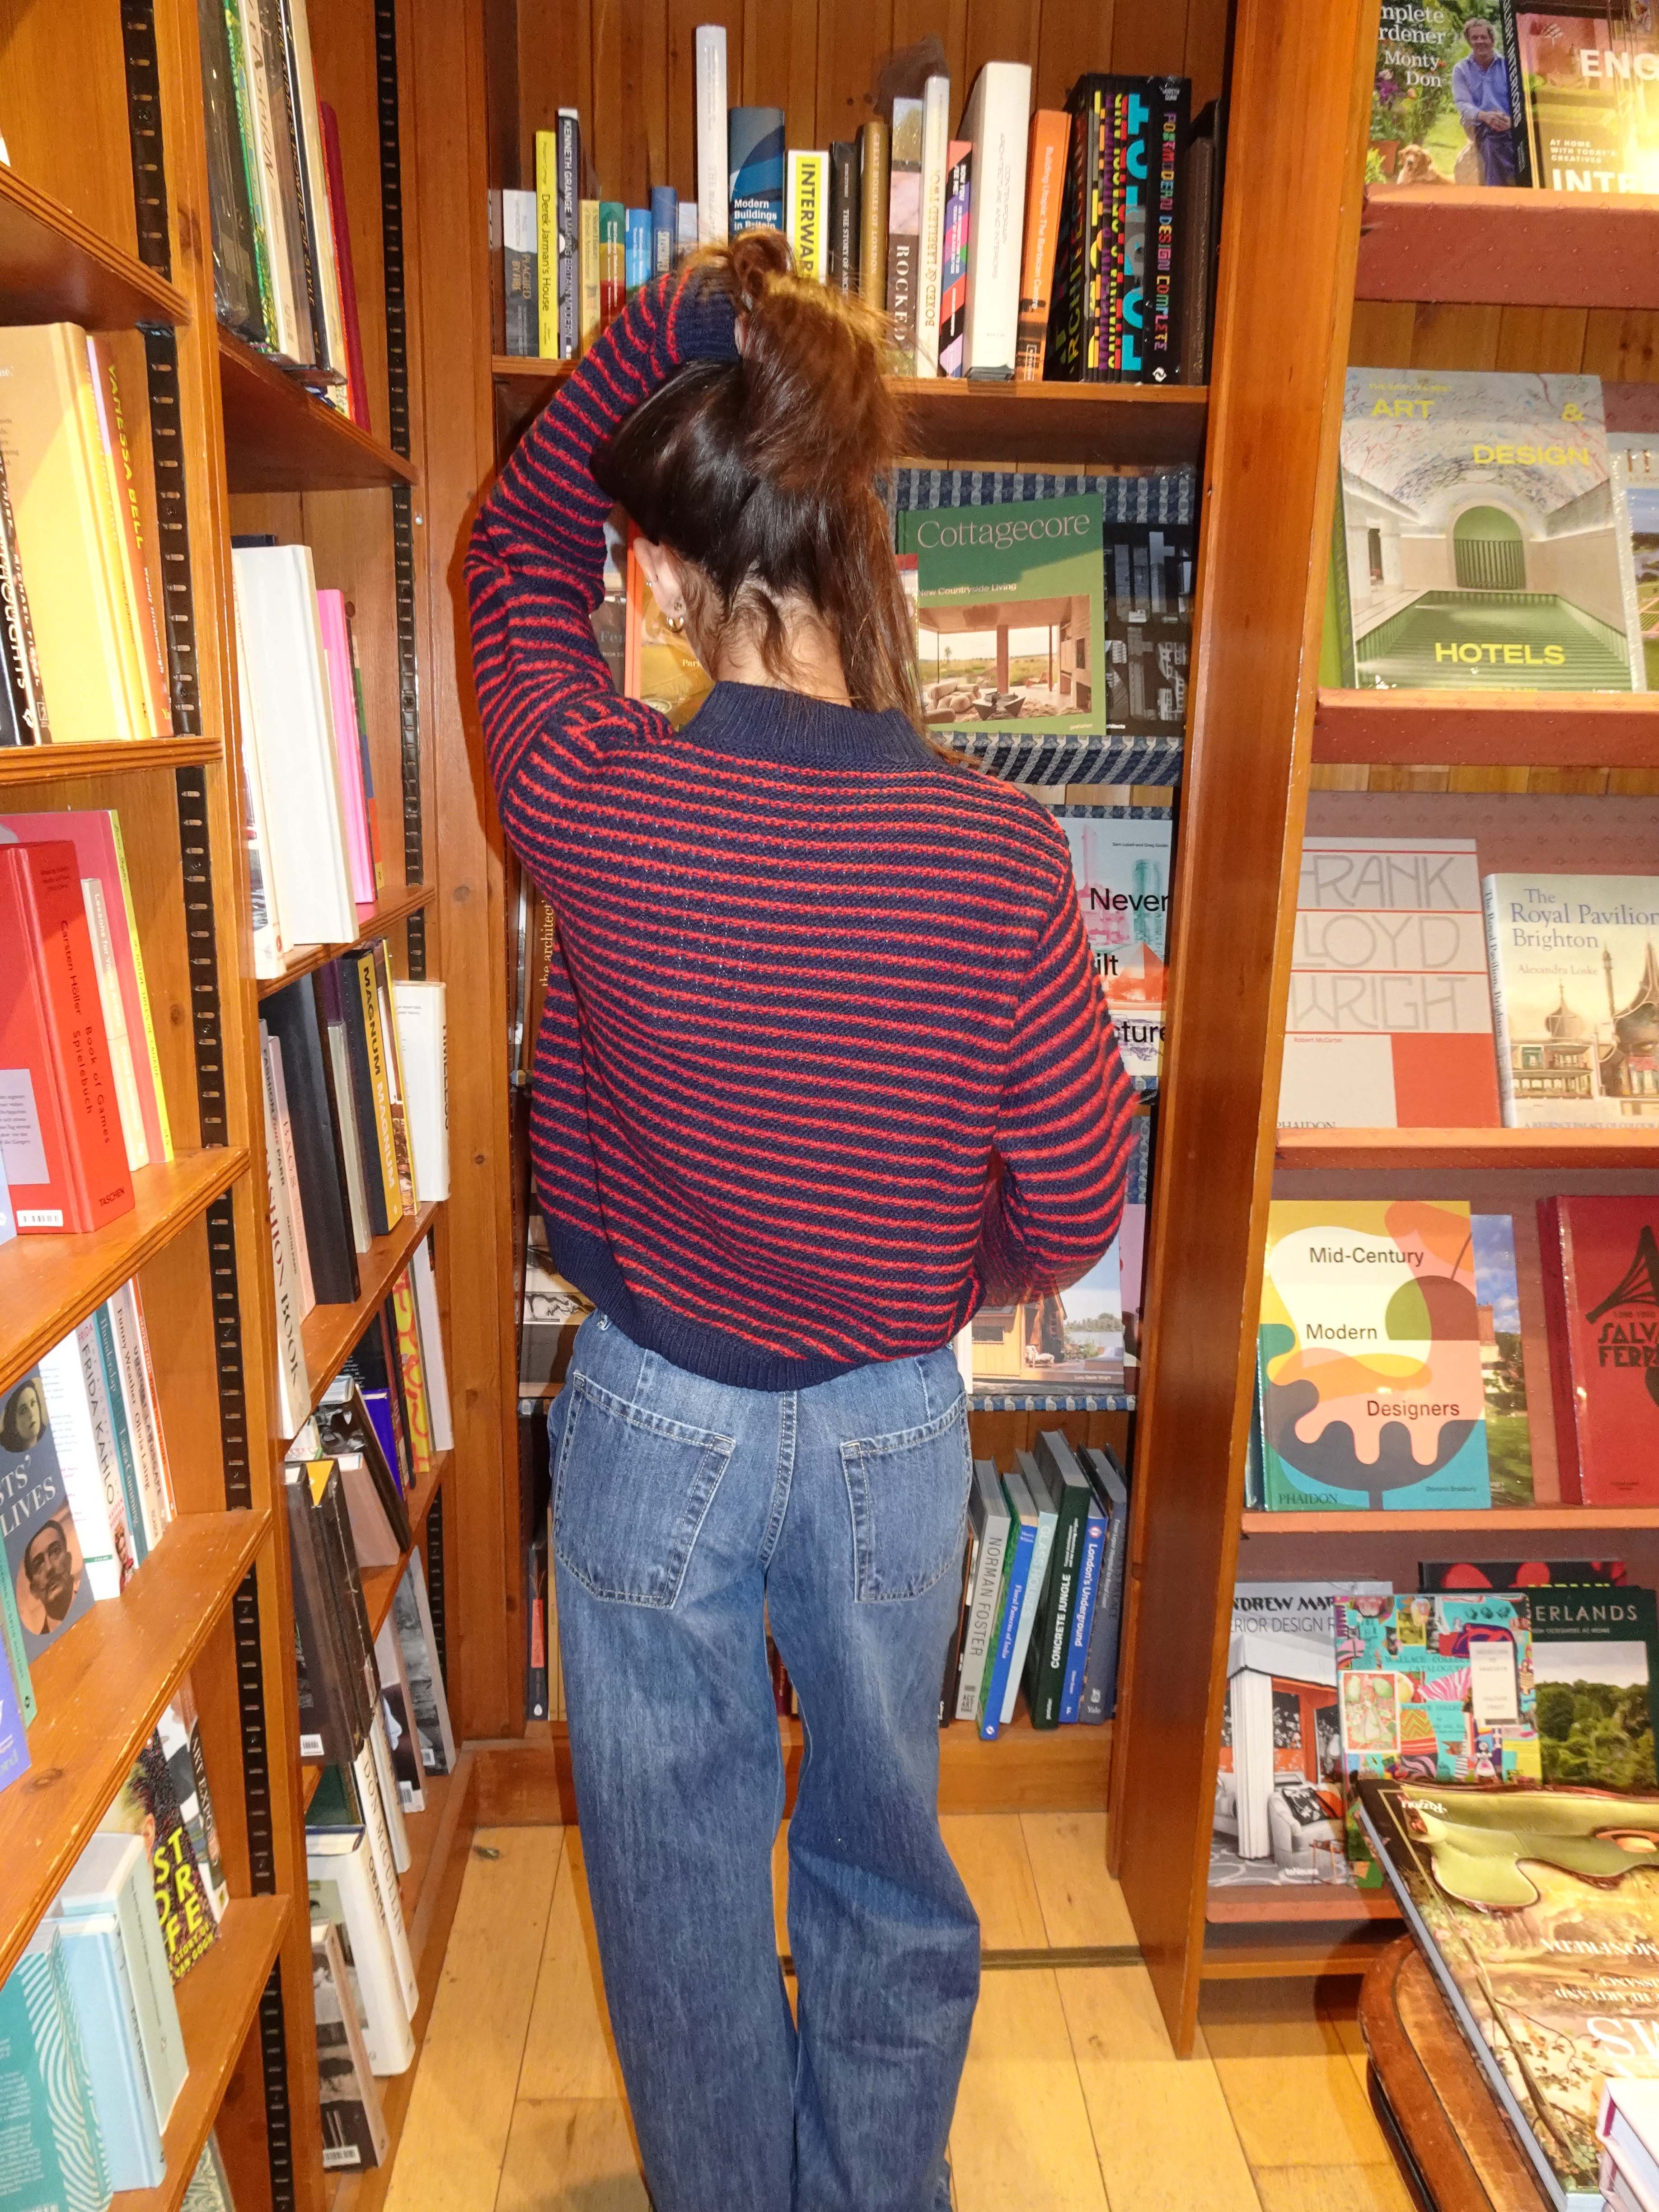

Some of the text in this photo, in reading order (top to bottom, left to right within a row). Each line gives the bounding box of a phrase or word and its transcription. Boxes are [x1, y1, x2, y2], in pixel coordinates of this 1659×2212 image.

[1385, 50, 1439, 72] Monty
[1406, 71, 1442, 87] Don
[1507, 45, 1521, 128] INTERIORS
[564, 120, 572, 169] KENNETH
[1160, 112, 1176, 211] POSTMODERN
[1551, 156, 1603, 164] CREATIVES
[1577, 149, 1616, 157] TODAY'S
[1041, 145, 1054, 183] Building
[542, 194, 550, 225] Derek
[564, 172, 572, 213] GRANGE
[734, 198, 769, 208] Modern
[734, 209, 777, 220] Buildings
[1039, 219, 1047, 236] The
[542, 229, 550, 274] Jarman's
[1035, 238, 1045, 276] Barbican
[1158, 216, 1173, 271] DESIGN
[842, 258, 849, 269] OF
[926, 270, 936, 281] &
[542, 276, 551, 311] House
[925, 285, 936, 327] BOXED
[1031, 279, 1041, 309] Centre
[1154, 275, 1171, 351] COMPLETE
[1371, 399, 1585, 422] ART &
[108, 365, 145, 549] VANESSA BELL
[1473, 445, 1590, 466] DESIGN
[918, 514, 1090, 549] Cottagecore
[144, 567, 153, 604] Wendy
[938, 583, 990, 595] Countryside
[991, 582, 1017, 593] Living
[1435, 642, 1566, 665] HOTELS
[1090, 888, 1169, 912] Never
[1485, 889, 1493, 909] The
[1525, 888, 1556, 904] The
[1486, 911, 1496, 942] Royal
[1511, 904, 1659, 928] Royal Pavilion
[94, 893, 106, 938] Lessons
[104, 956, 115, 990] Young
[1513, 928, 1599, 951] Brighton
[61, 919, 83, 1017] Carsten Höller
[539, 966, 549, 987] the
[1518, 963, 1598, 975] Alexandra Loske
[1494, 992, 1503, 1037] Brighton
[72, 1030, 92, 1115] Spielebuch
[85, 1026, 110, 1144] Book of Games
[363, 966, 395, 1189] MAGNUM MAGNUM
[263, 1048, 285, 1186] FASHION PARR
[99, 1186, 125, 1207] TASCHEN
[1309, 1247, 1425, 1267] Mid-Century
[139, 1315, 148, 1351] GRAYSON
[280, 1293, 299, 1387] BOOK
[1306, 1324, 1378, 1340] Modern
[117, 1308, 150, 1491] Funny Weather Olivia Laing
[1367, 1400, 1460, 1420] Designers
[81, 1344, 115, 1505] FRIDA KAHLO
[0, 1476, 56, 1537] LIVES
[1279, 1493, 1338, 1505] PHAIDON
[969, 1537, 1003, 1656] NORMAN FOSTER
[1074, 1543, 1098, 1647] London's Underground
[1050, 1611, 1067, 1669] CONCRETE
[1059, 1574, 1071, 1607] JUNGLE
[1272, 1617, 1323, 1633] DESIGN
[1537, 1605, 1639, 1622] ERLANDS
[1087, 1705, 1101, 1714] Yale
[193, 1736, 204, 1774] ART
[362, 1762, 378, 1814] DON
[368, 1856, 386, 1926] OBAMA
